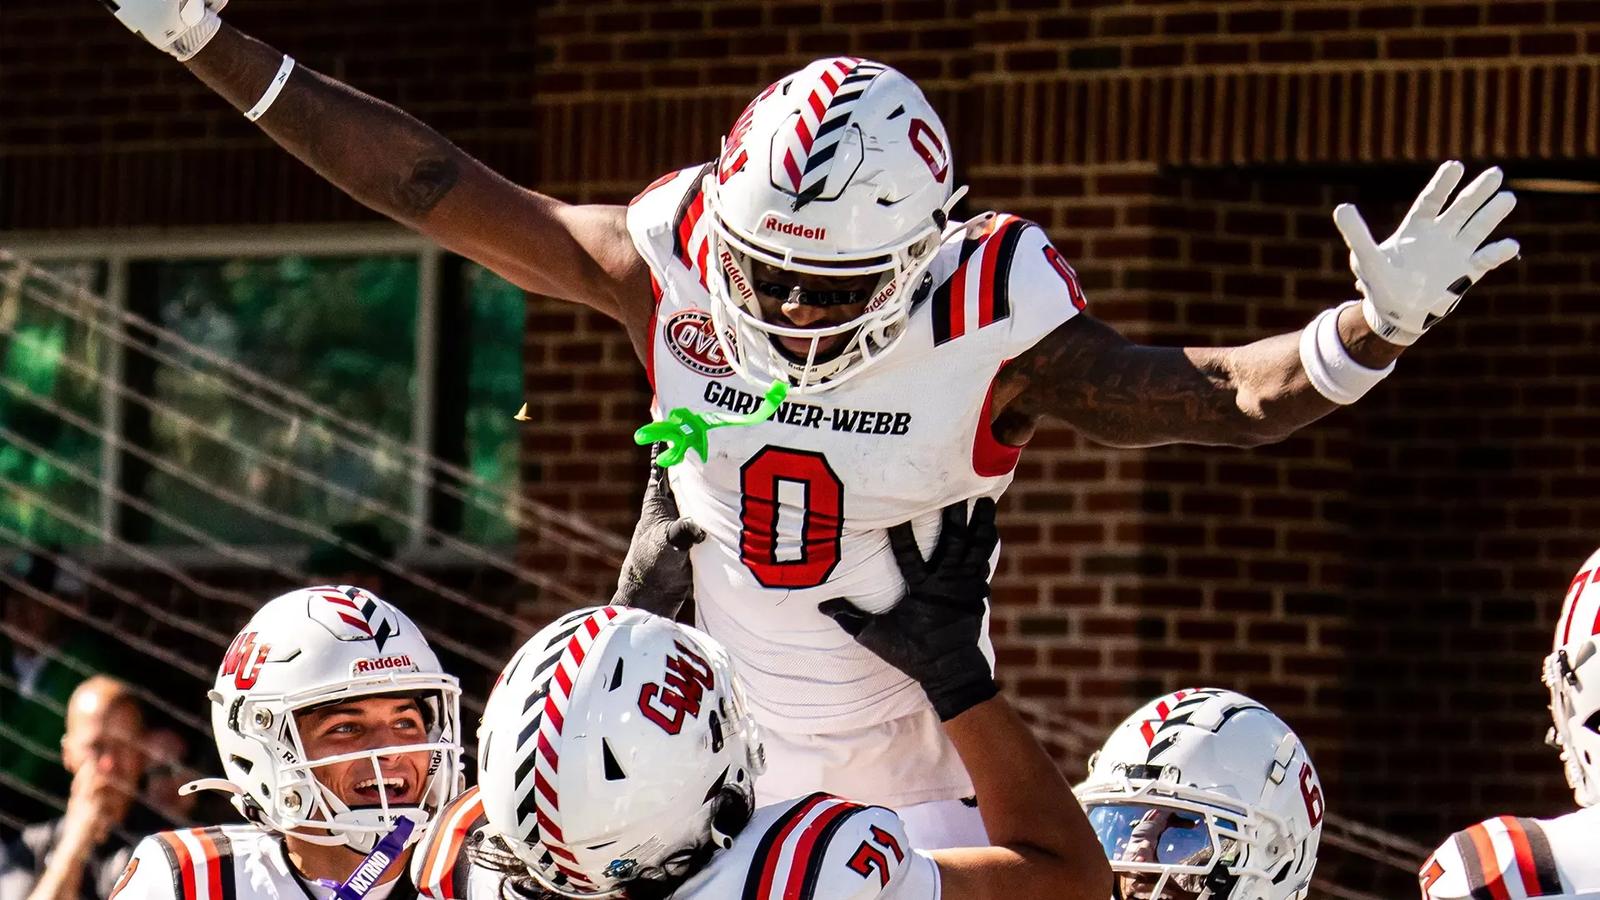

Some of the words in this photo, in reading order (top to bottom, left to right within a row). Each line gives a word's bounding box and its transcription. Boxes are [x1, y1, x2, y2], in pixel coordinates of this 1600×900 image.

[907, 117, 949, 184] 0
[765, 217, 826, 240] Riddell
[720, 250, 753, 300] Riddell
[677, 324, 721, 364] OVC
[739, 444, 845, 590] 0
[357, 655, 411, 672] Riddell
[638, 640, 715, 736] GWU
[1299, 762, 1324, 830] 6
[348, 851, 390, 896] NXTRND
[845, 824, 905, 891] 71
